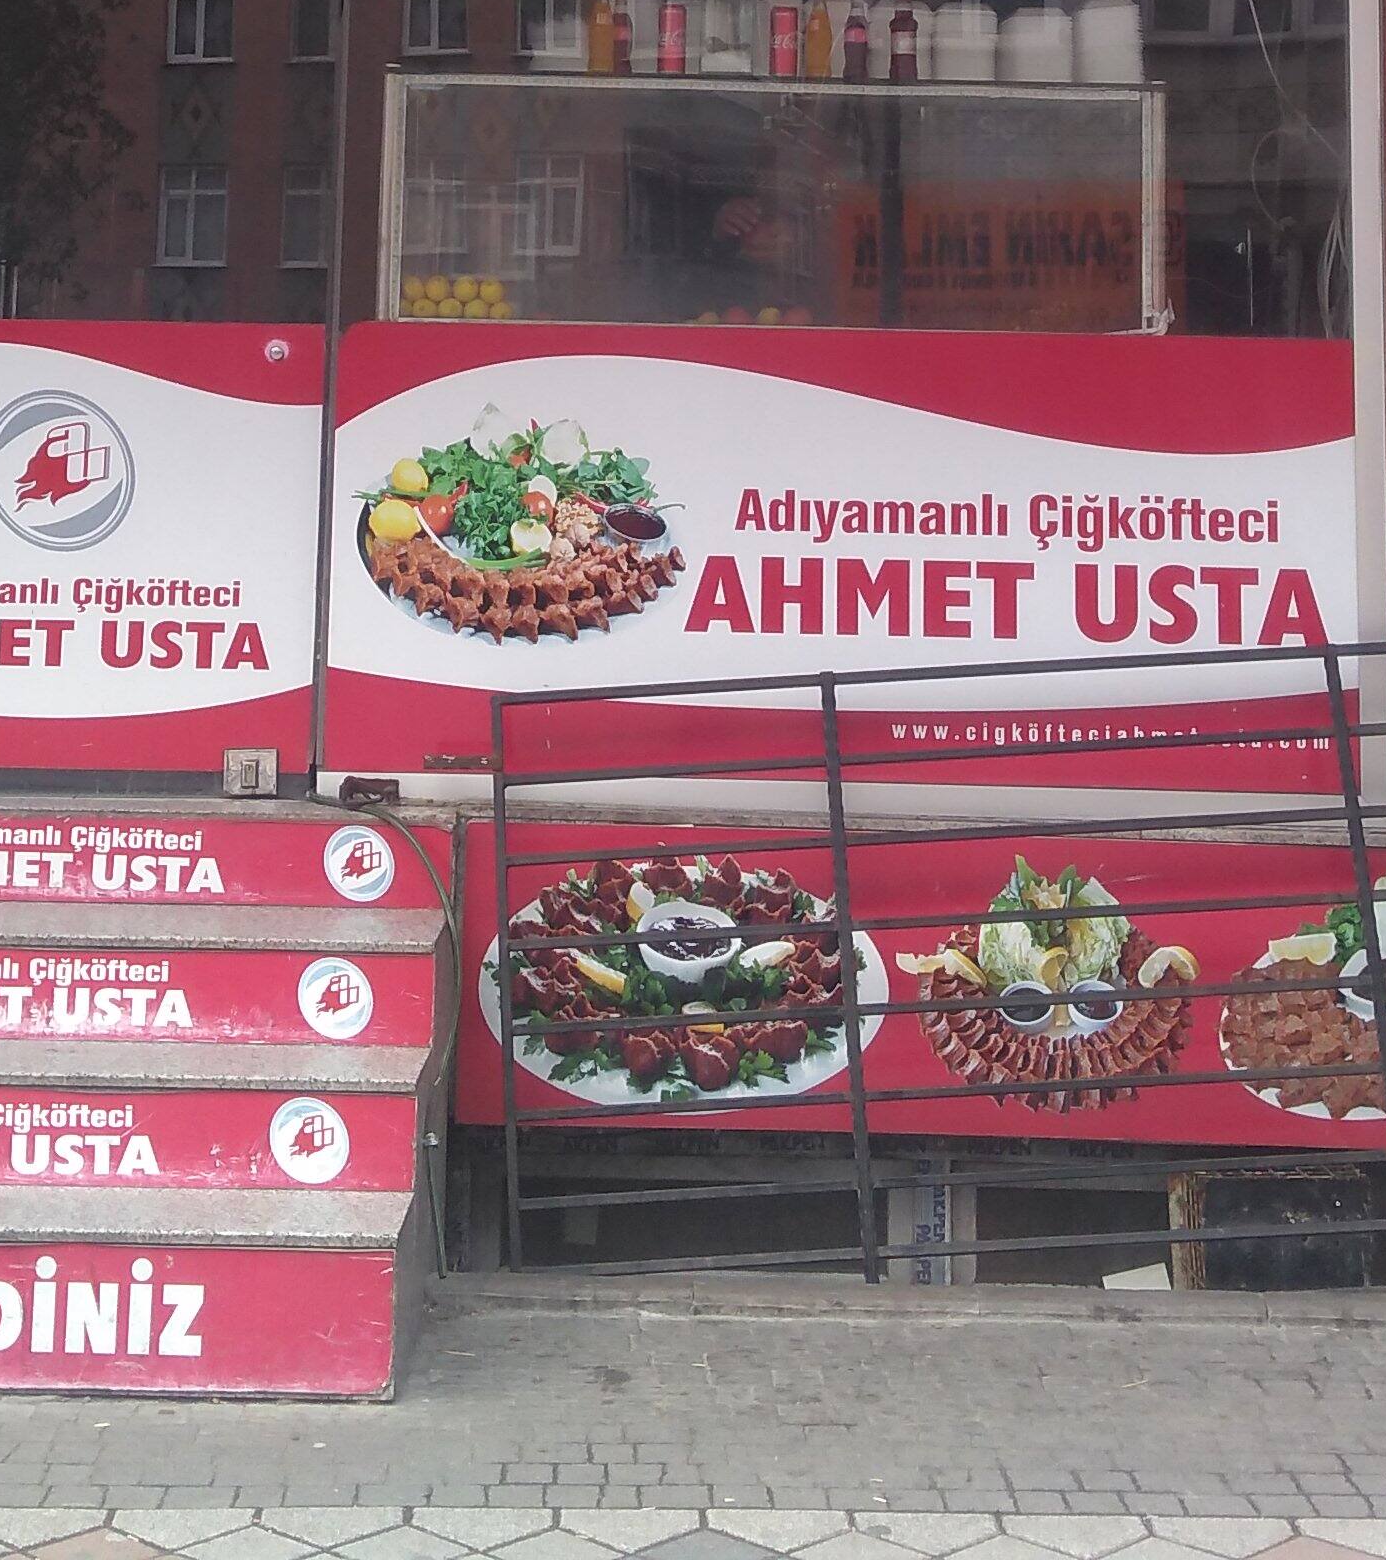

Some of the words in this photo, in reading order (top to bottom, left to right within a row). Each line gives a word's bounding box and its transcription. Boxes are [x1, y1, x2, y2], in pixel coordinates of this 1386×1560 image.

[734, 487, 1009, 544] Adıyamanlı
[1028, 493, 1280, 553] Çiğköfteci
[72, 577, 243, 614] Çiğköfteci
[683, 554, 1036, 641] AHMET
[1073, 562, 1331, 647] USTA
[98, 620, 271, 671] USTA
[70, 824, 203, 854] Çiğköfteci
[90, 856, 226, 894] USTA
[28, 957, 170, 988] Çiğköfteci
[51, 986, 194, 1029] USTA
[10, 1133, 160, 1177] USTA
